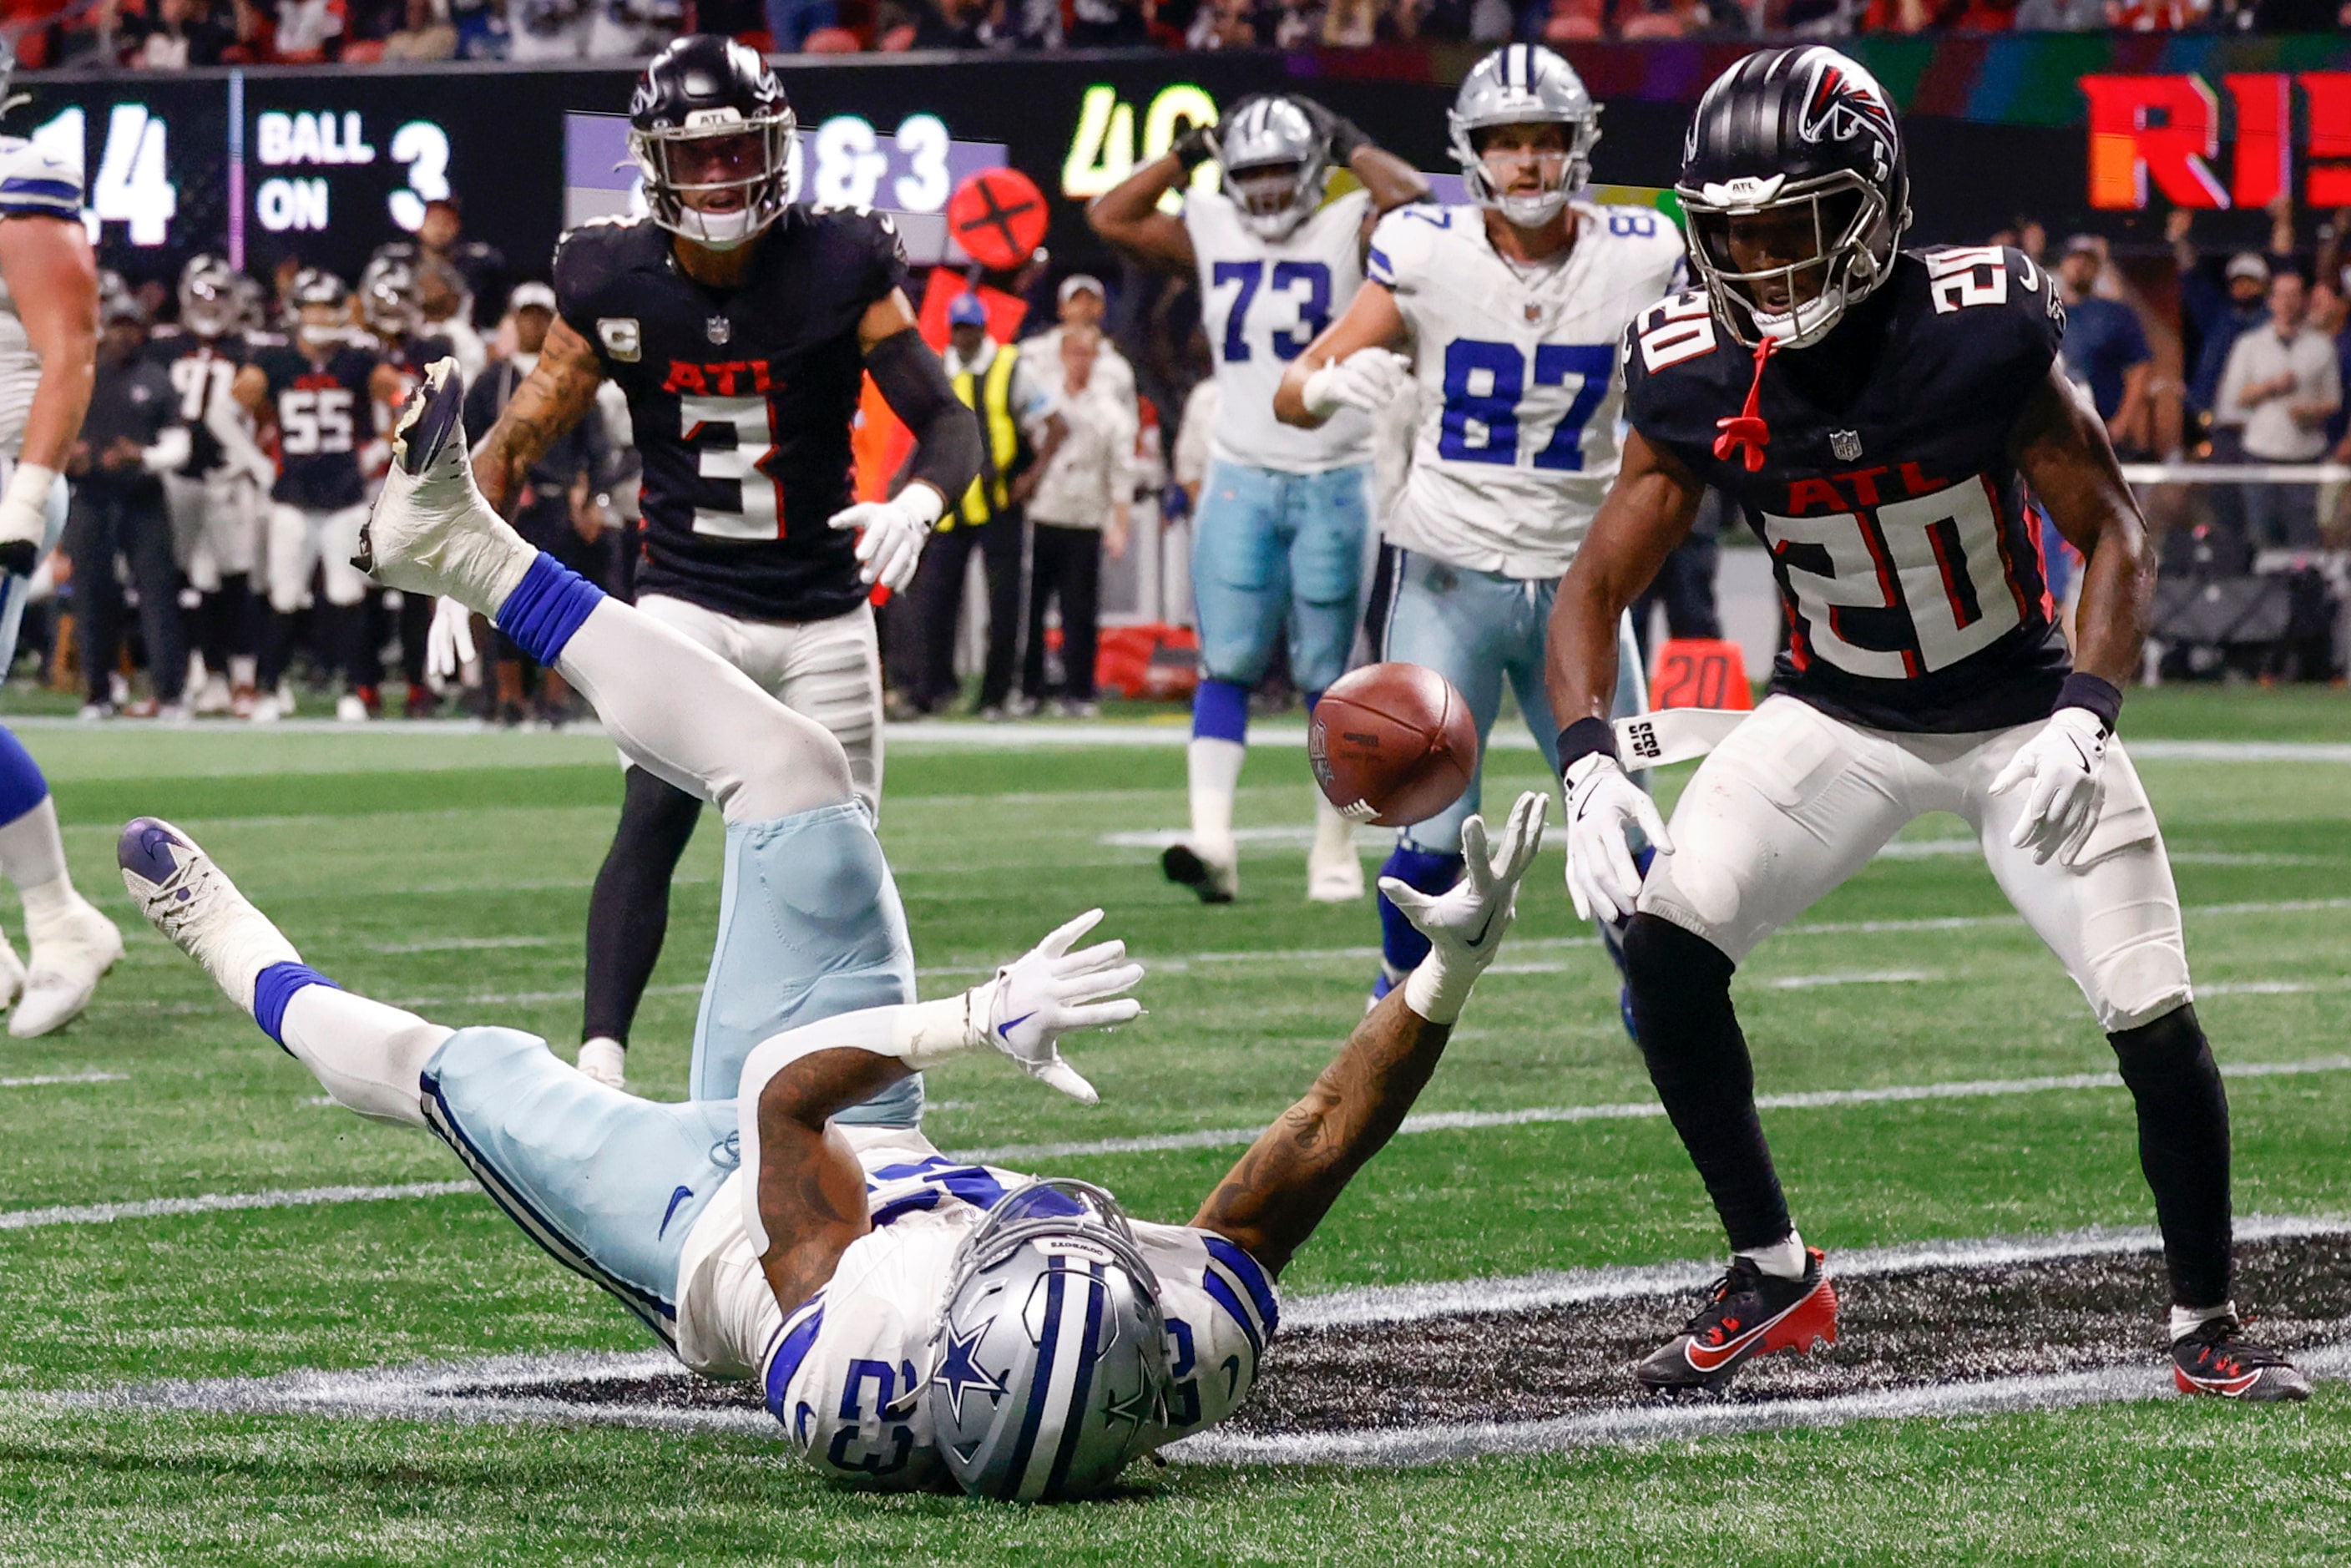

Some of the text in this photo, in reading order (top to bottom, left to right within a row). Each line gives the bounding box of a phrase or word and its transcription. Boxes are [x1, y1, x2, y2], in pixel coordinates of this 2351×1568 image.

[256, 109, 376, 165] BALL
[700, 114, 729, 124] ATL
[255, 175, 330, 231] ON
[387, 119, 451, 234] 3
[1732, 181, 1756, 192] ATL
[1403, 205, 1451, 230] 7
[1606, 205, 1656, 240] 8
[1924, 245, 2007, 315] 20
[600, 322, 637, 352] C
[1214, 260, 1332, 362] 73
[1637, 290, 1718, 377] 20
[662, 361, 786, 396] ATL
[1438, 338, 1616, 472] 87
[278, 387, 354, 455] 55
[680, 394, 786, 540] 3
[1787, 462, 1951, 515] ATL
[1760, 473, 2027, 680] 20
[1661, 655, 1729, 710] 20
[1050, 1242, 1104, 1257] COWBOYS
[827, 1358, 918, 1475] 23
